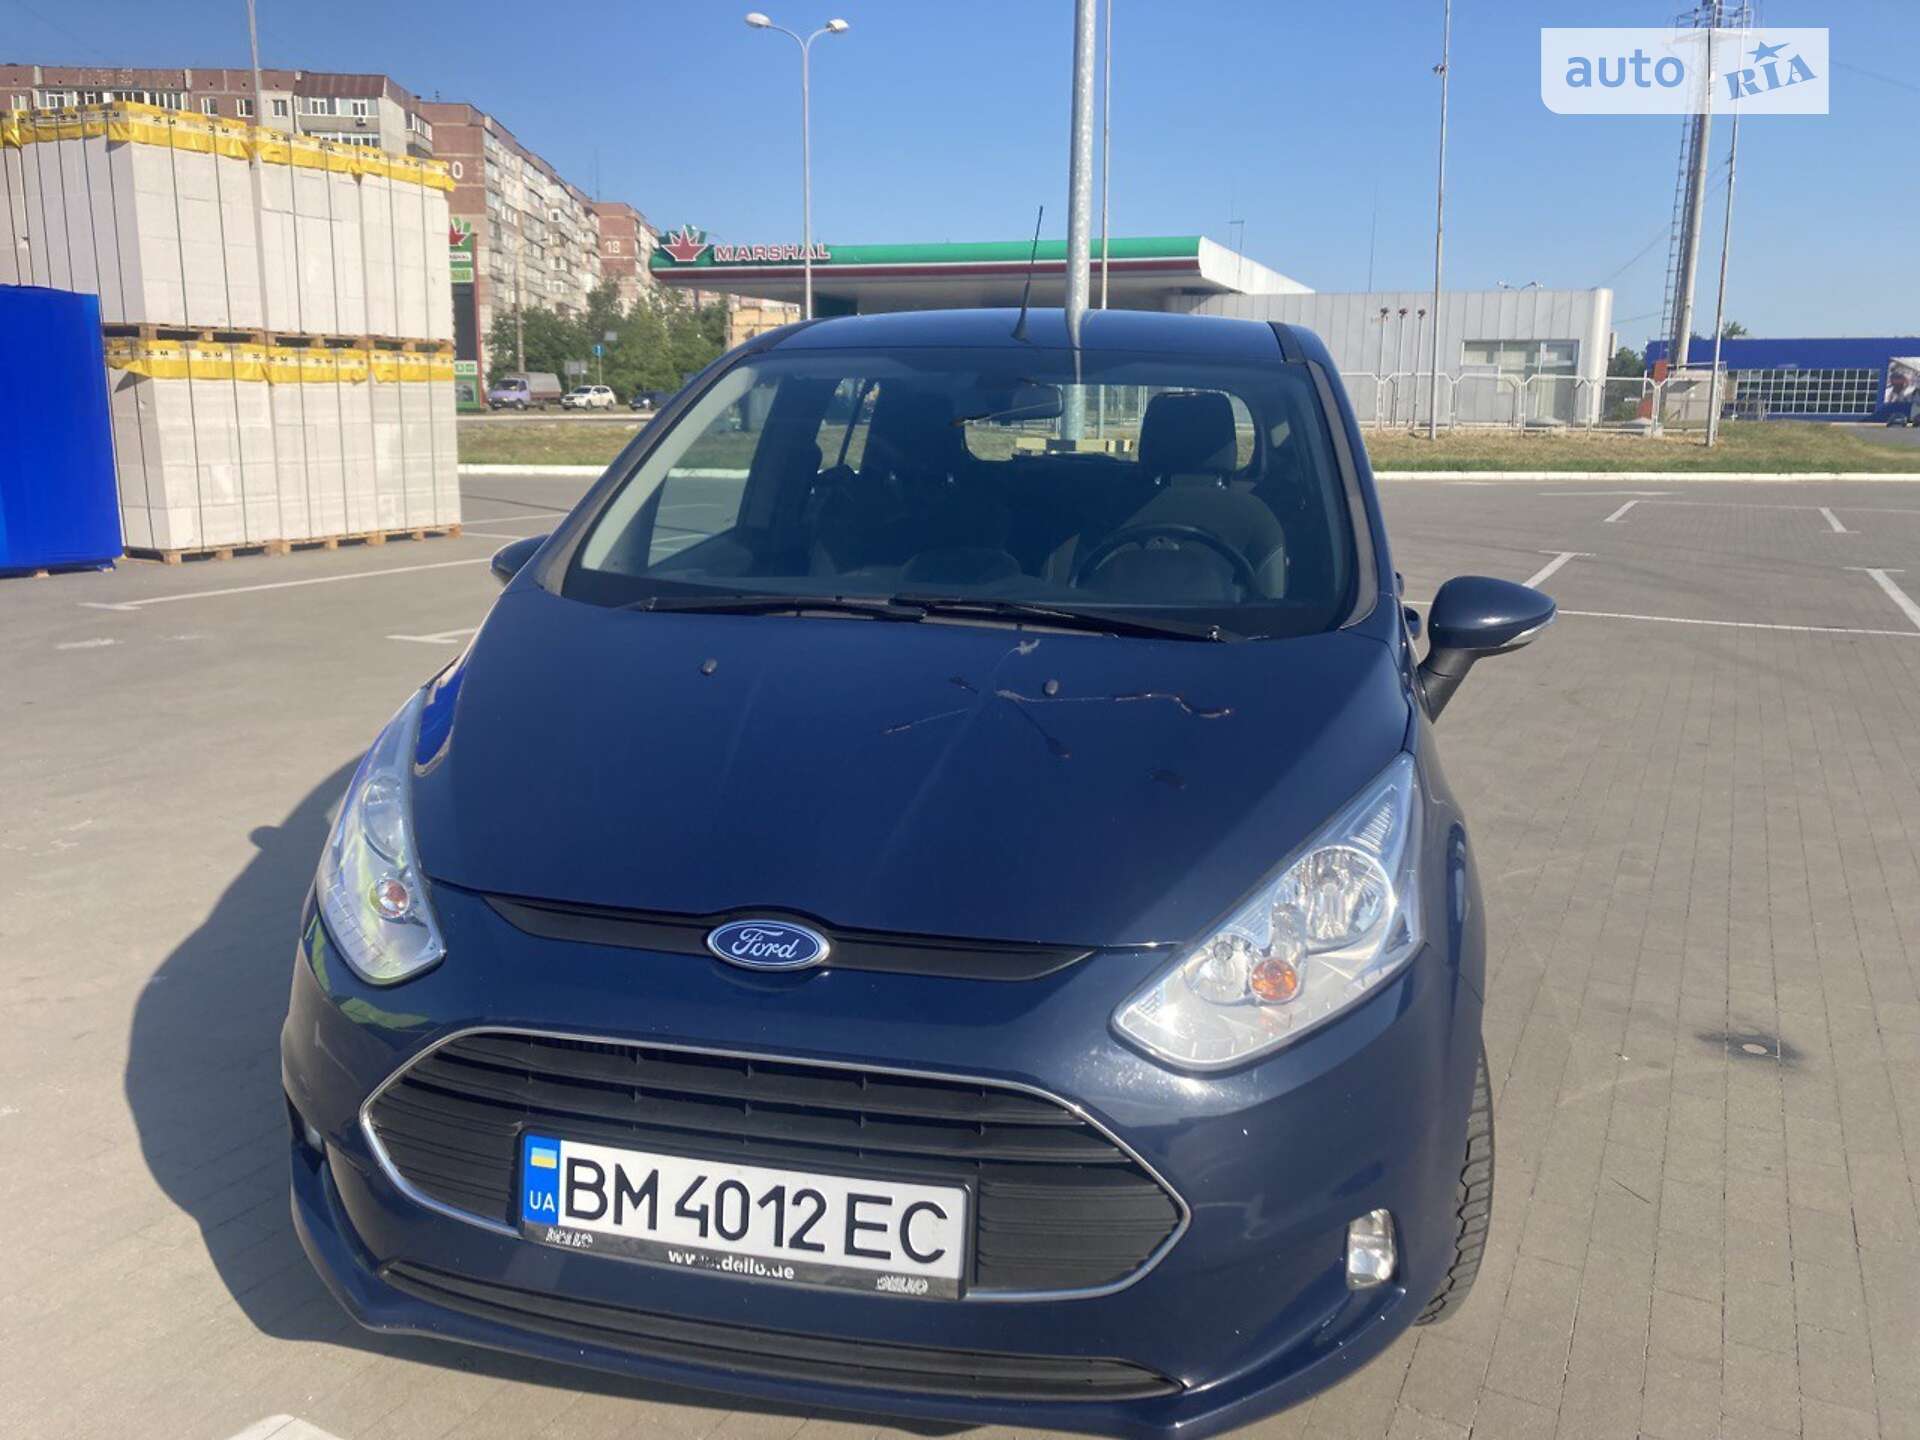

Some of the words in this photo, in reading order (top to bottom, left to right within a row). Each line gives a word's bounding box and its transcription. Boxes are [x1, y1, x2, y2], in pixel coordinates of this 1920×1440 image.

[604, 240, 621, 254] 18
[714, 243, 832, 262] MARSHAL
[732, 927, 799, 958] Ford
[529, 1190, 556, 1213] UA
[564, 1157, 659, 1231] BM
[674, 1175, 827, 1254] 4012
[845, 1193, 949, 1264] EC
